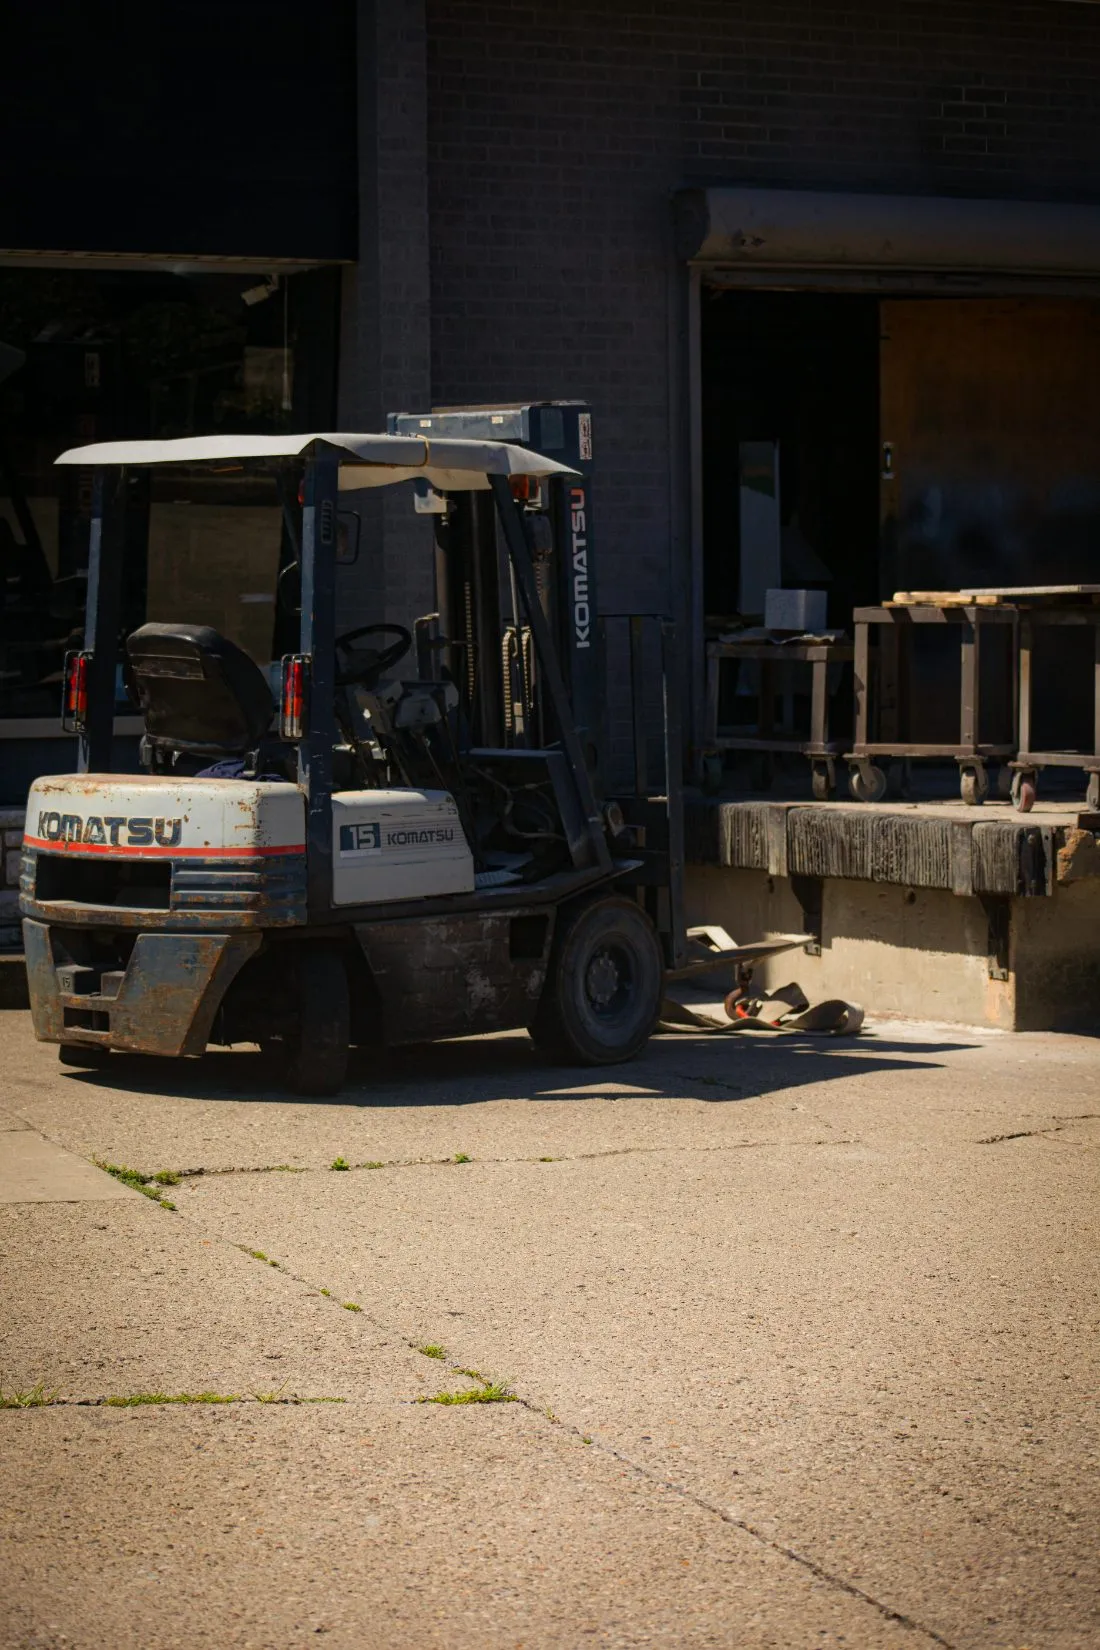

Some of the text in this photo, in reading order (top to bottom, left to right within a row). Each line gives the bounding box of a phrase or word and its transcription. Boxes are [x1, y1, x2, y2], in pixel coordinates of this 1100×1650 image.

[570, 488, 590, 649] KOMATSU
[38, 811, 182, 847] KOMATSU
[349, 824, 454, 850] 15 KOMATSU
